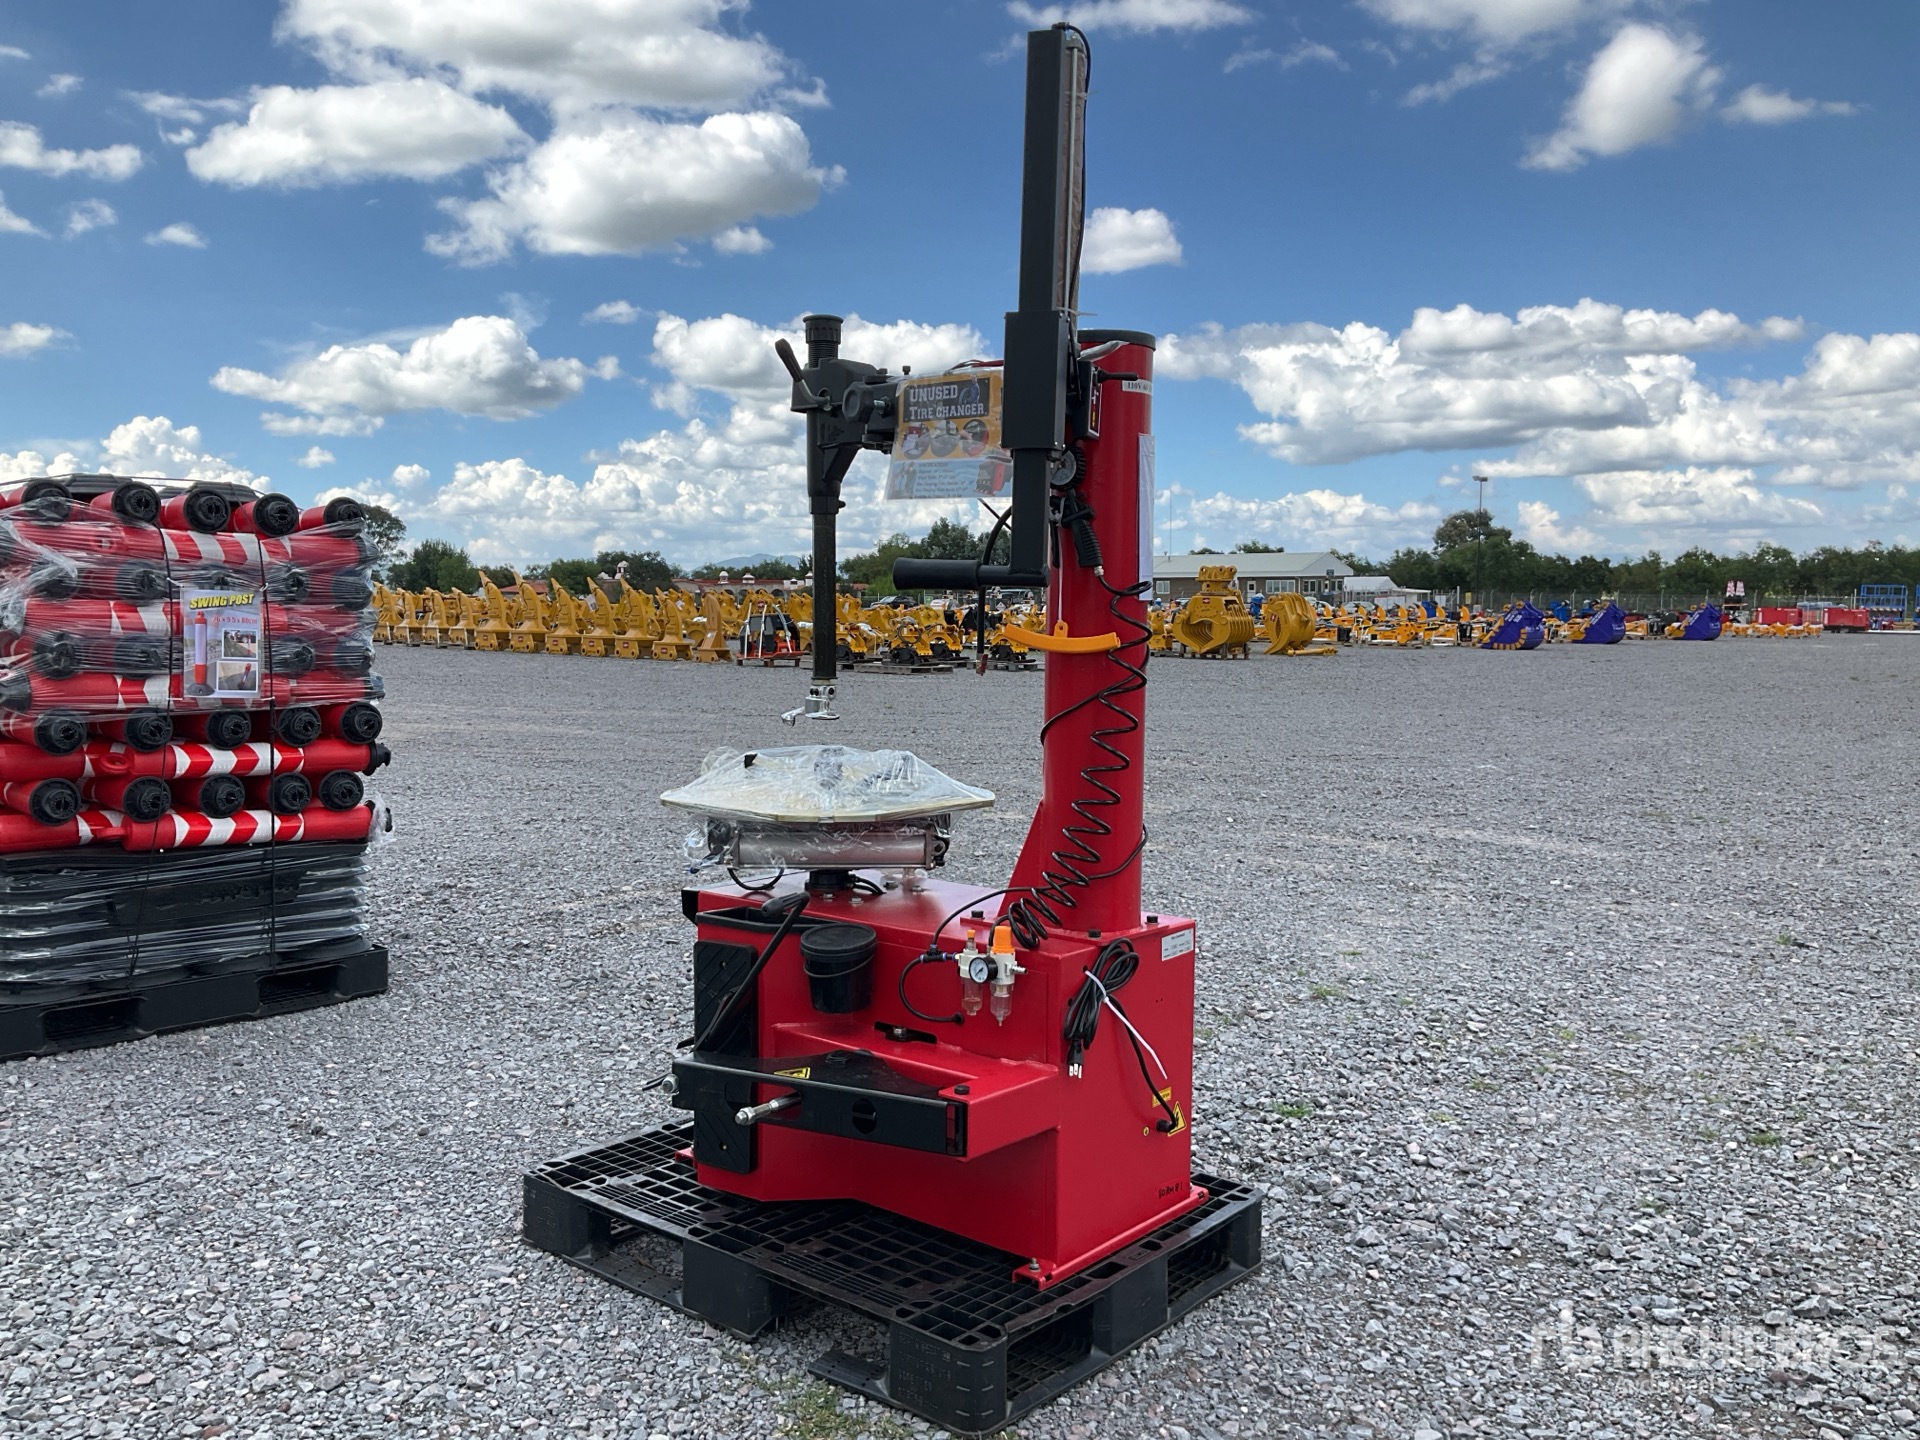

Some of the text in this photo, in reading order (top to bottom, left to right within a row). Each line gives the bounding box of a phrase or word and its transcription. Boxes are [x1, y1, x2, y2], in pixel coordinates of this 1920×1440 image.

[909, 385, 958, 403] UNUSED
[909, 403, 984, 420] TIRE CHANGER
[190, 594, 255, 609] SWING POST
